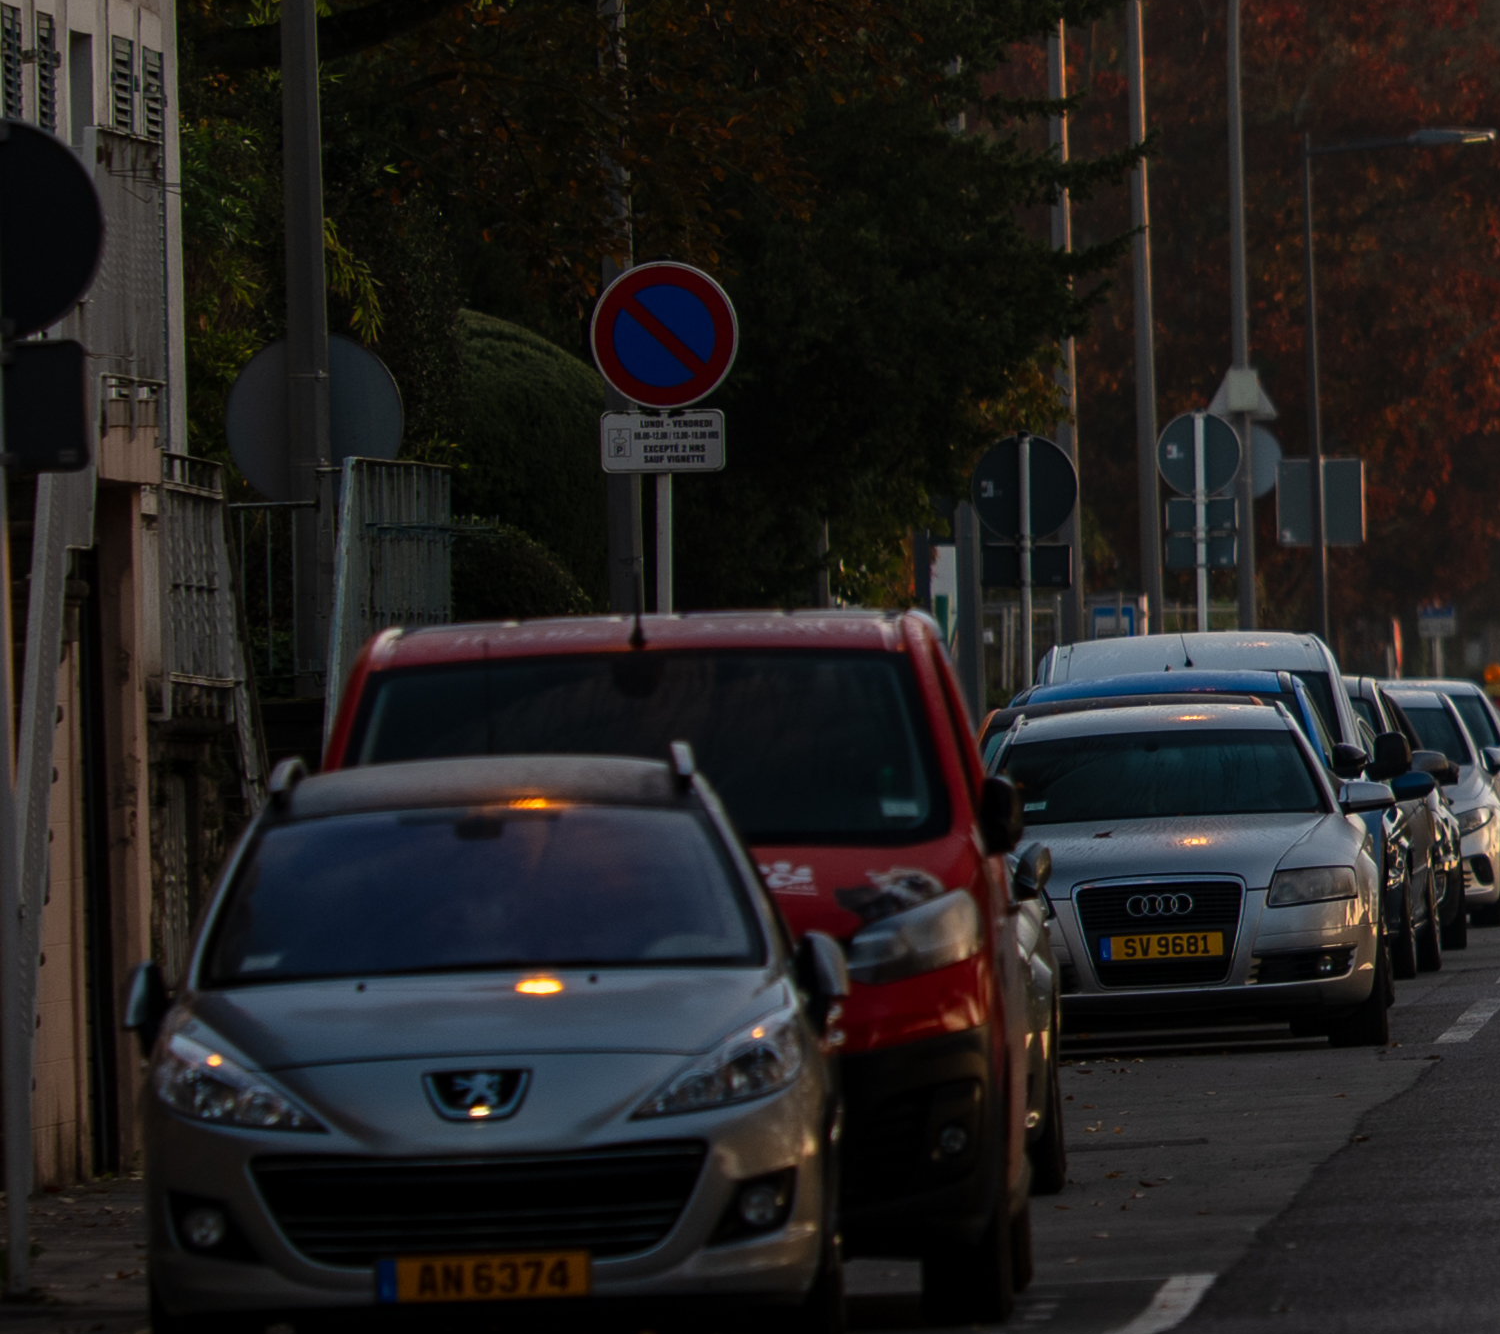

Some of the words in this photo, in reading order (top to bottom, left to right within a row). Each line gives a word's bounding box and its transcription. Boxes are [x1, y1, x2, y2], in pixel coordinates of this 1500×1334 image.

[640, 419, 664, 428] LUNDI
[672, 419, 713, 428] VENDREDI
[643, 443, 679, 453] EXCEPTÉ
[681, 444, 687, 453] 2
[688, 444, 706, 453] HRS
[643, 455, 664, 464] SAUF
[666, 454, 706, 464] VIGNETTE
[1123, 937, 1151, 957] SV
[1157, 935, 1210, 956] 9681
[418, 1264, 464, 1296] AN
[473, 1259, 570, 1295] 6374
